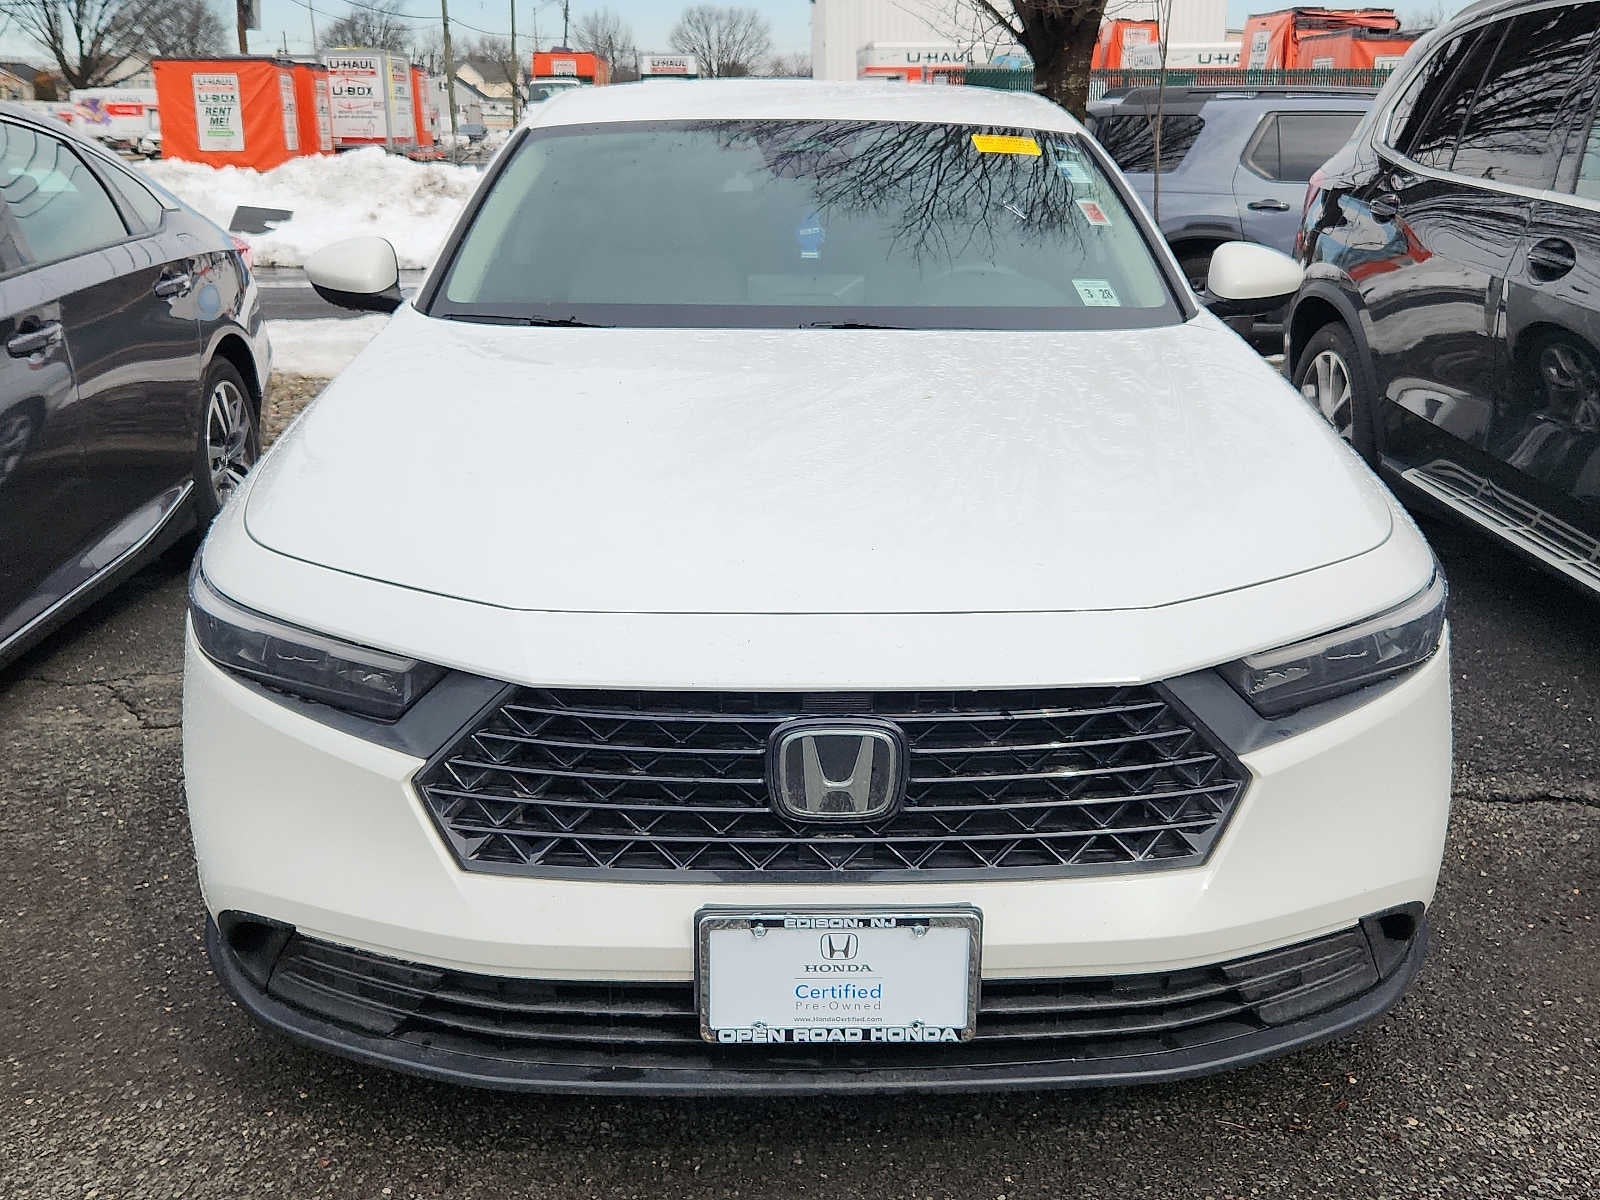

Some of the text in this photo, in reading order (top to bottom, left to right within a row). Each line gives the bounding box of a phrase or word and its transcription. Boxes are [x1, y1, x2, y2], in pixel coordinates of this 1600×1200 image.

[907, 52, 976, 65] U-HAUL
[329, 60, 375, 69] U-HAUL
[332, 86, 374, 96] U-BOX
[198, 94, 236, 103] U-BOX
[205, 107, 232, 117] RENT
[209, 117, 230, 127] ME!
[870, 917, 897, 929] NJ
[804, 964, 873, 973] HONDA
[794, 983, 882, 999] Certified
[794, 1000, 882, 1011] Pre-Owned
[718, 1027, 961, 1043] OPEN ROAD HONDA
